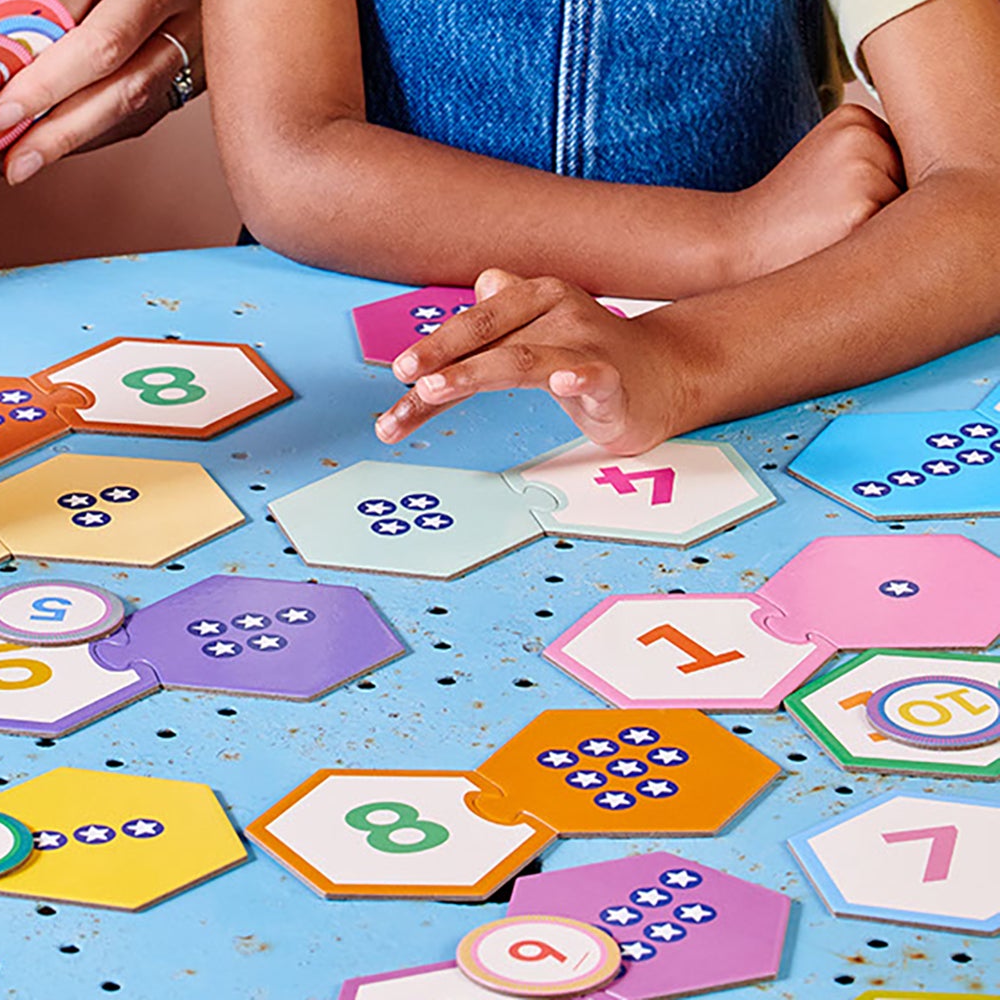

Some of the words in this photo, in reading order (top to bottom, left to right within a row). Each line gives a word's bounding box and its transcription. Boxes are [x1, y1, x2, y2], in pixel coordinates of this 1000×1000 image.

[120, 366, 203, 406] 8
[594, 466, 676, 505] 4
[30, 596, 75, 622] 5
[636, 624, 745, 674] 1
[898, 688, 991, 727] 10
[344, 801, 450, 854] 8
[881, 825, 959, 883] 7
